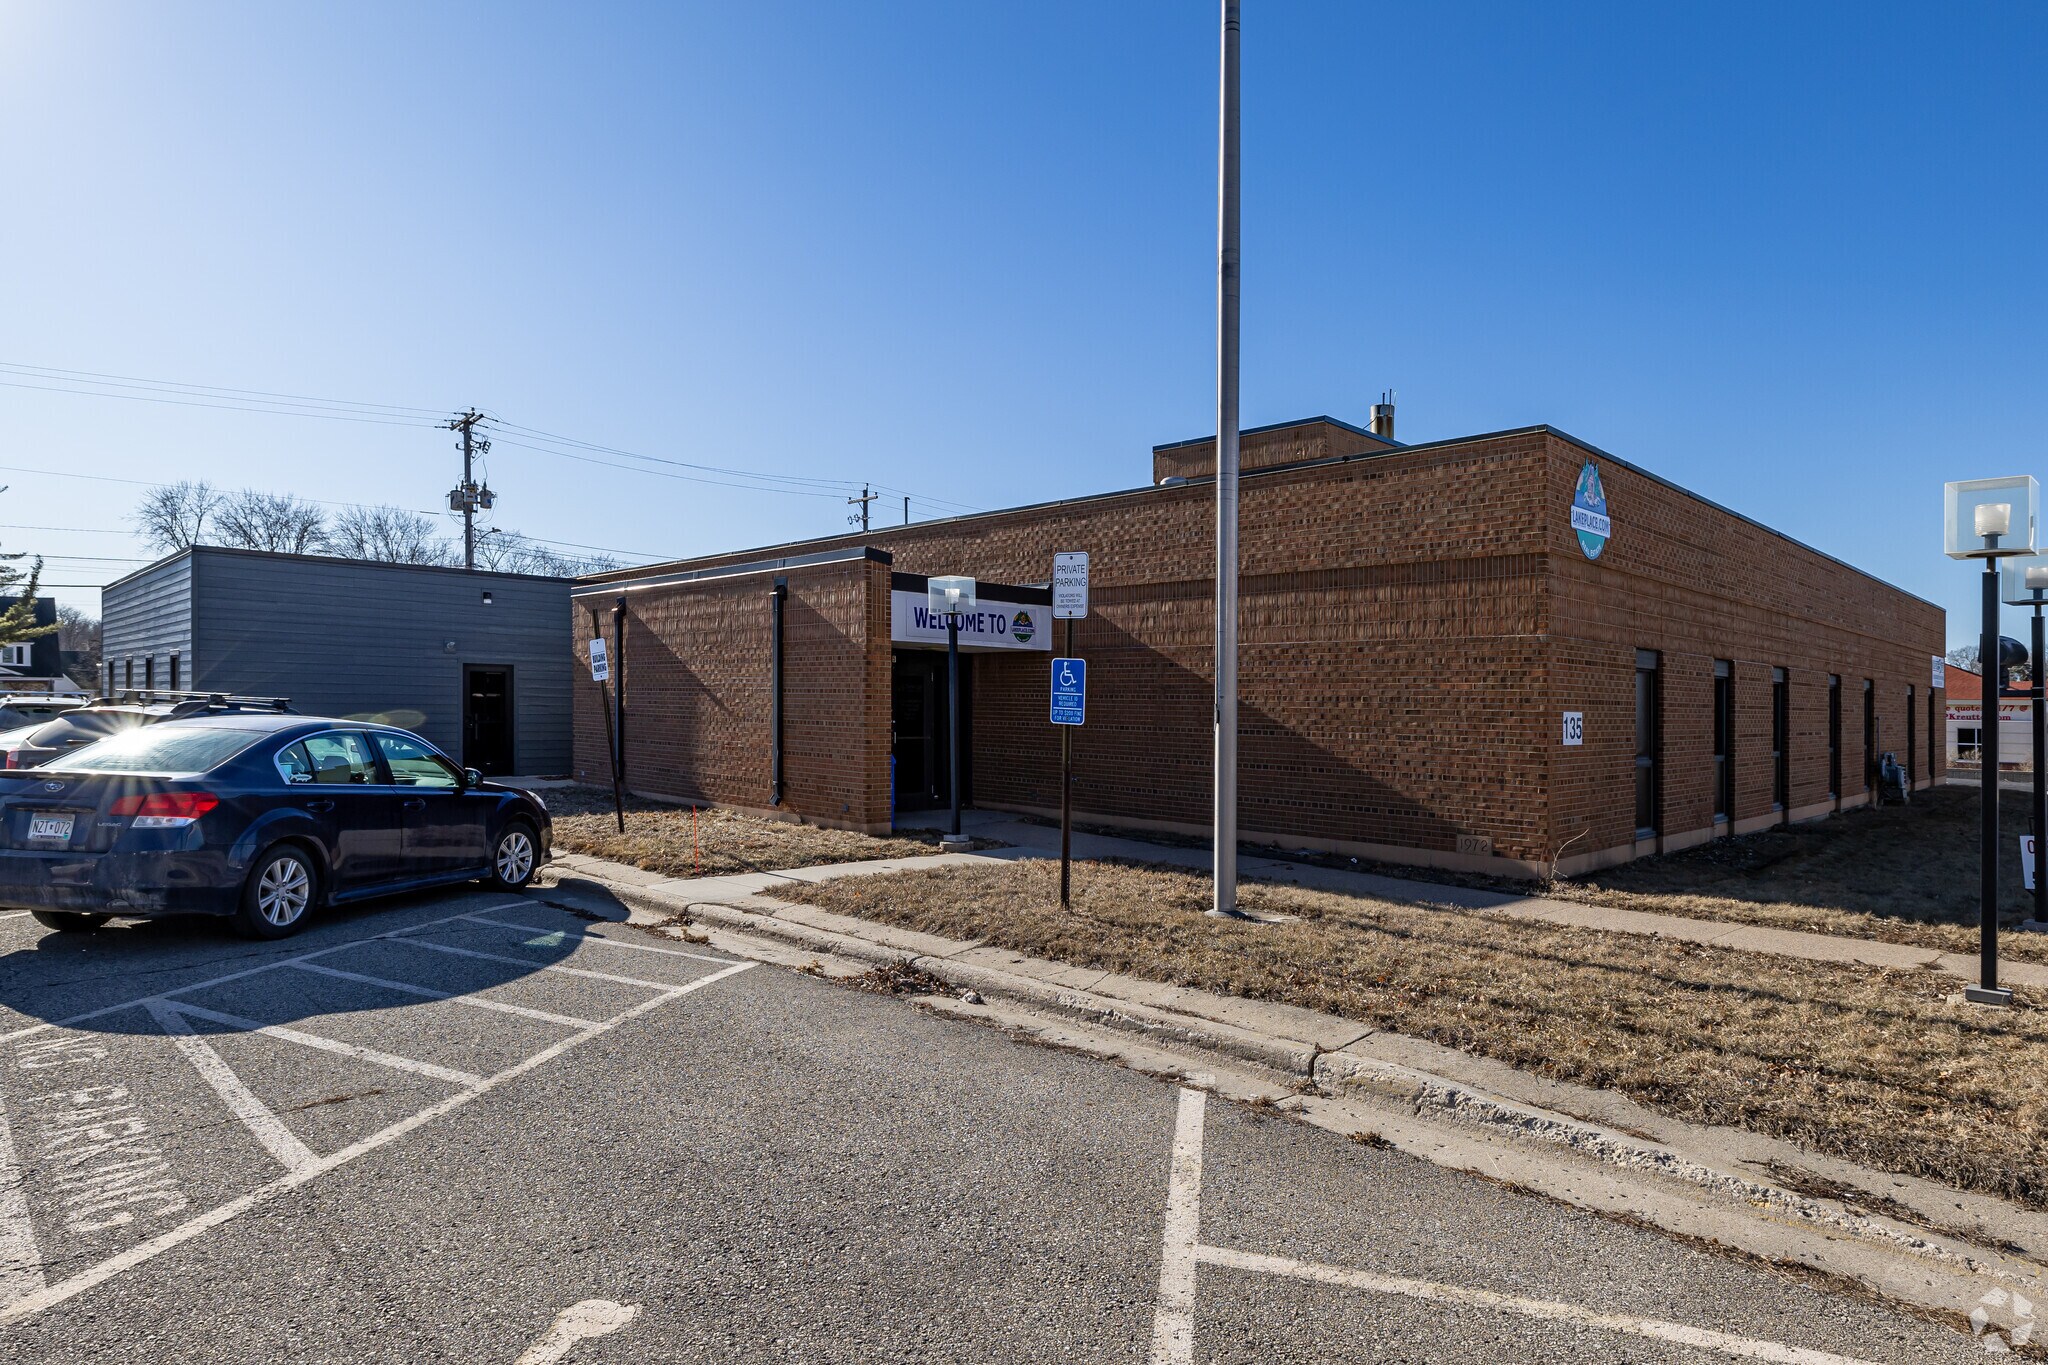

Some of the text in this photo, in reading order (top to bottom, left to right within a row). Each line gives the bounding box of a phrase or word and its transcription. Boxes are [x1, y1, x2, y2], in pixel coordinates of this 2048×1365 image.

[1573, 509, 1610, 532] LAKEPLACE.COM
[1057, 565, 1085, 574] PRIVATE
[1056, 577, 1086, 587] PARKING
[914, 607, 1006, 634] WELCOME TO
[1564, 717, 1582, 739] 135
[32, 820, 71, 834] NZT 072
[1460, 838, 1488, 852] 1972
